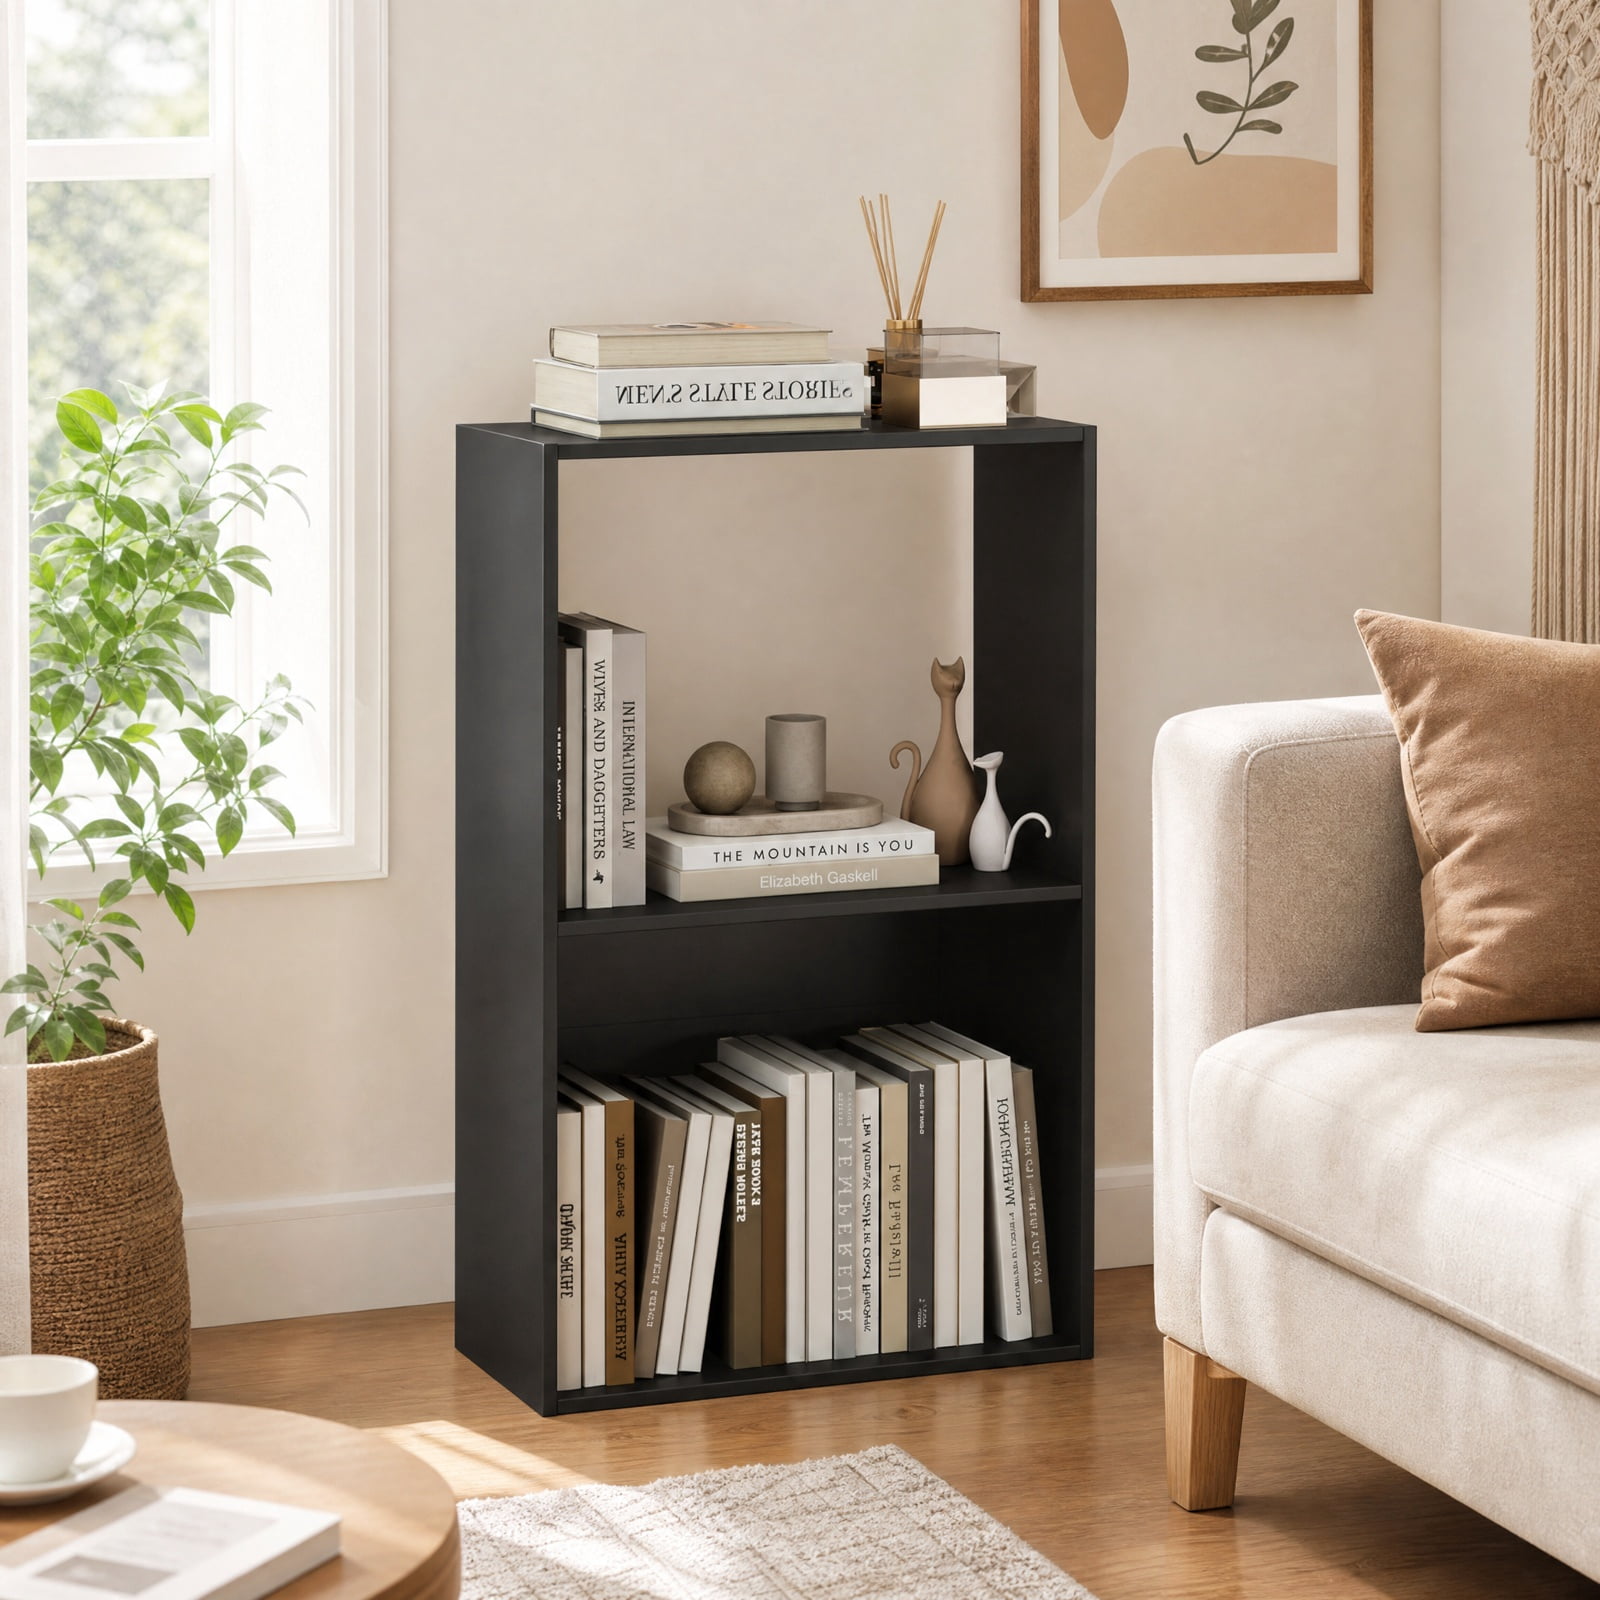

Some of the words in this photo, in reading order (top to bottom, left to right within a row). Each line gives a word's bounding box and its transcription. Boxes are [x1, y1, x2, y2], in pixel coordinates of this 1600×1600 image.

[593, 718, 606, 753] AND
[622, 820, 636, 850] LAW
[713, 850, 743, 864] THE
[753, 843, 848, 861] MOUNTAIN
[856, 842, 870, 853] IS
[878, 839, 914, 852] YOU
[760, 871, 823, 889] Elizabeth
[827, 868, 878, 885] Gaskell
